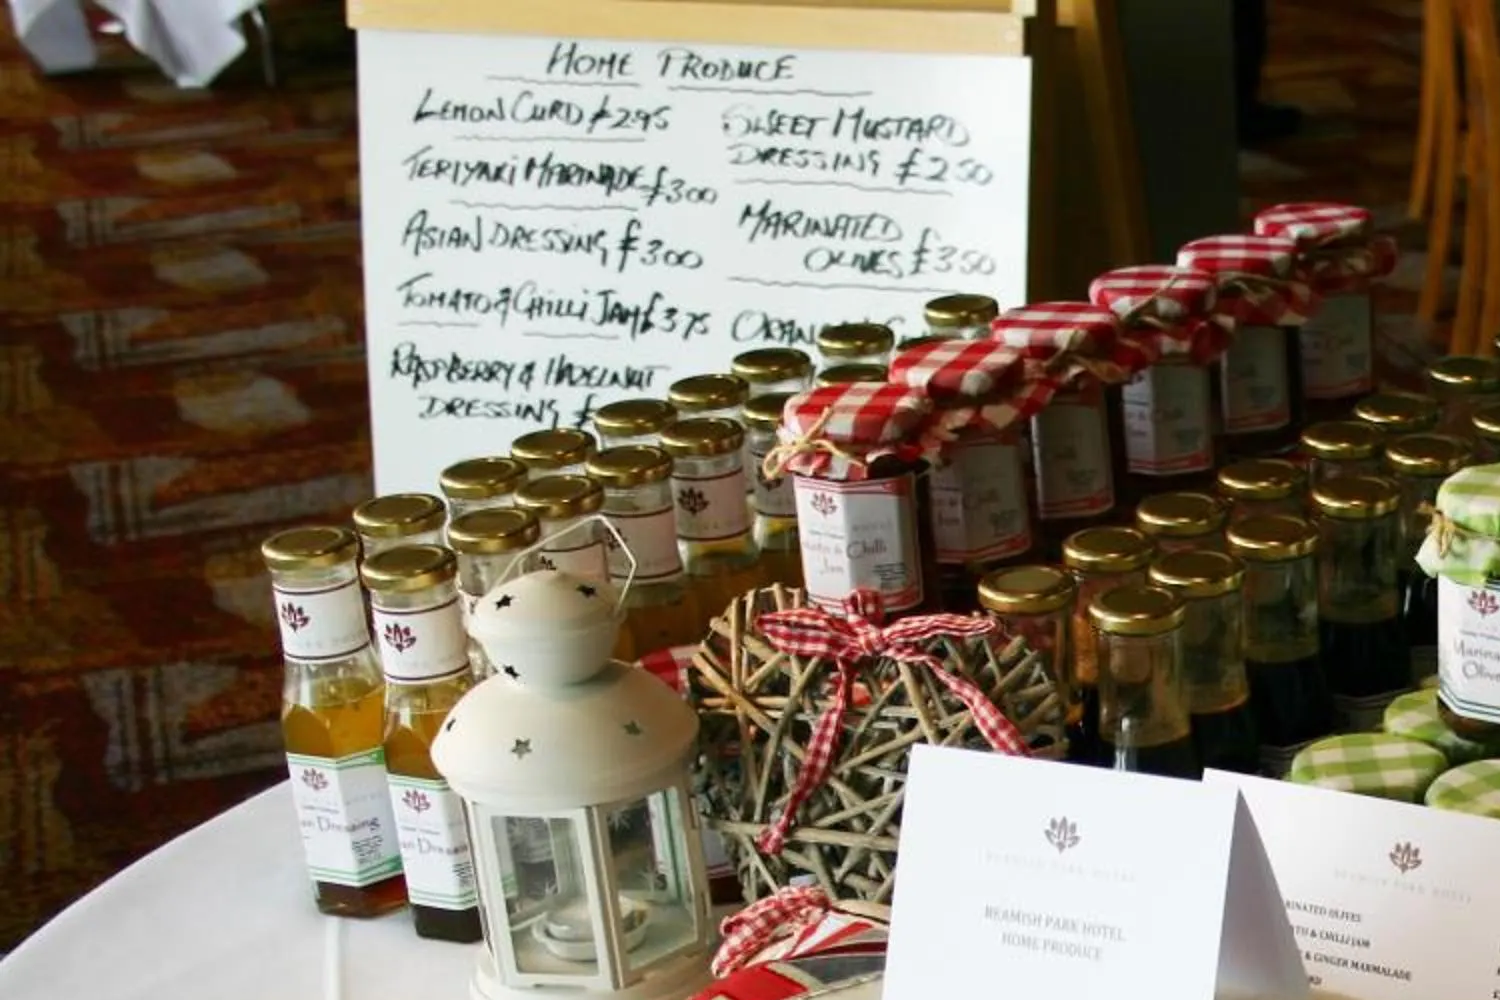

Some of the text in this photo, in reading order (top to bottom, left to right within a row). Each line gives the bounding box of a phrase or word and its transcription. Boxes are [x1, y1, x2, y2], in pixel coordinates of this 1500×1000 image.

[546, 42, 798, 82] HOME PRODUCE
[413, 87, 505, 123] LEMON
[509, 90, 584, 125] CURD
[721, 104, 970, 147] SWEET MUSTARD
[726, 143, 880, 176] DRESSING
[402, 209, 482, 257] ASIAN
[489, 221, 608, 267] DRESSING
[739, 199, 903, 243] MARINATED
[803, 247, 904, 279] OLIVES
[397, 272, 491, 315] TOMATO
[592, 289, 640, 340] JAM
[418, 395, 559, 429] DRESSING
[985, 904, 1126, 941] BEAMISH PARK HOTEL
[1285, 900, 1327, 916] RINATED
[1002, 932, 1039, 951] HOME
